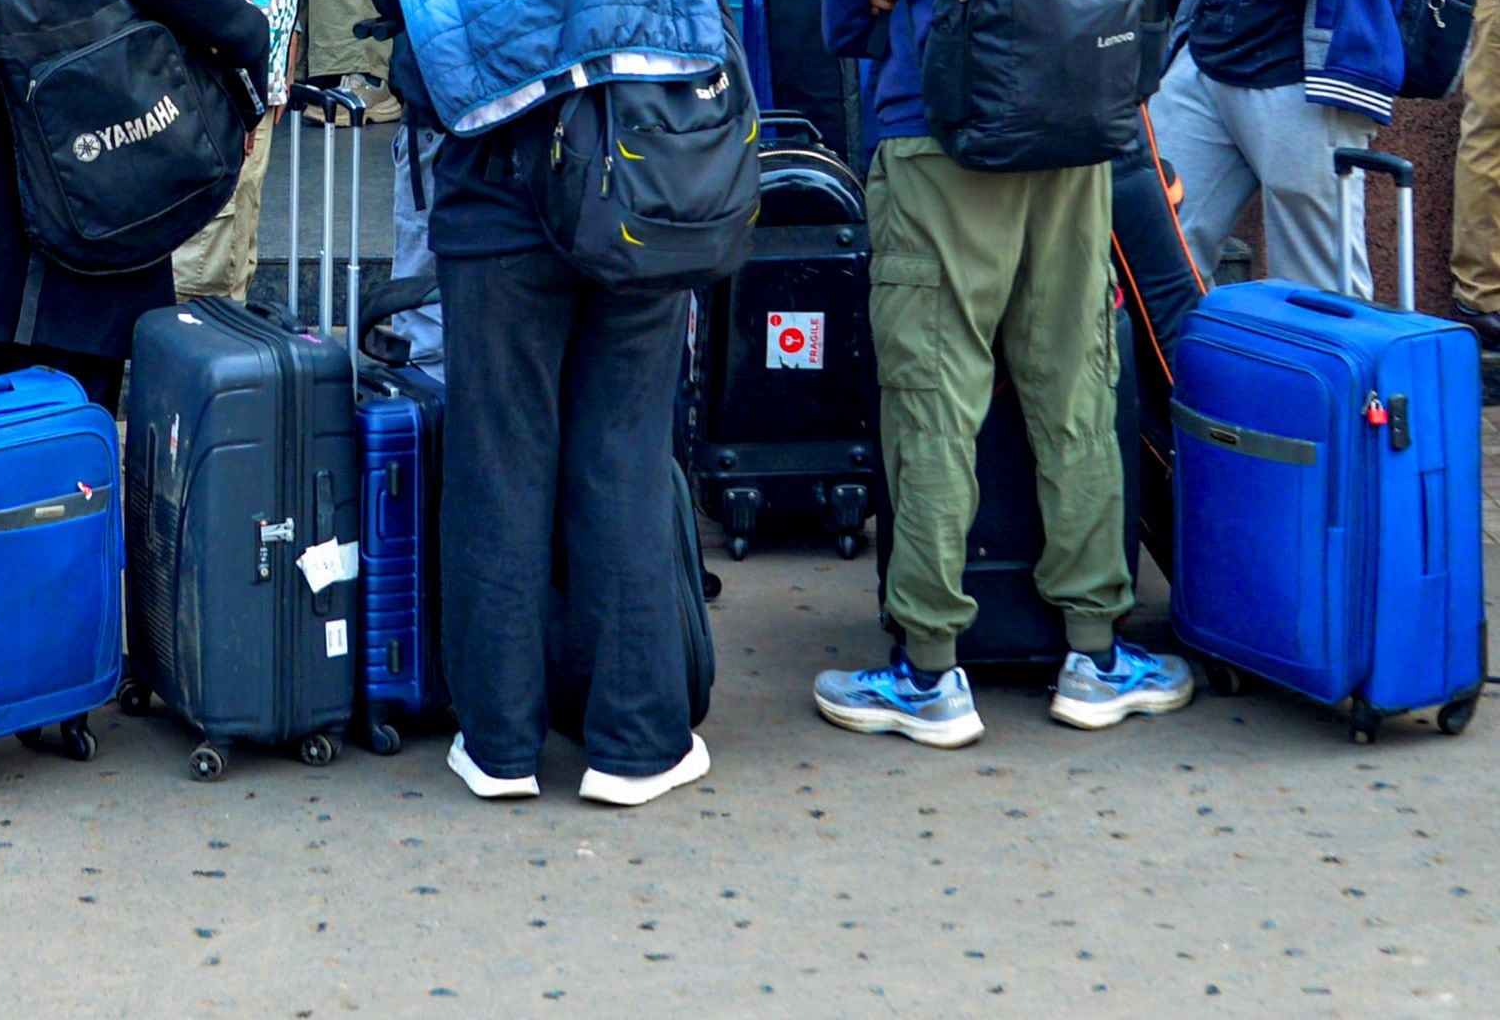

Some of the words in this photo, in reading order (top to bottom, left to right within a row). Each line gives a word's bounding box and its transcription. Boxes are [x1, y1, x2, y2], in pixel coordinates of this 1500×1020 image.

[1097, 31, 1136, 48] Lenovo
[96, 95, 180, 151] YAMAHA
[808, 318, 820, 364] FRAGILE
